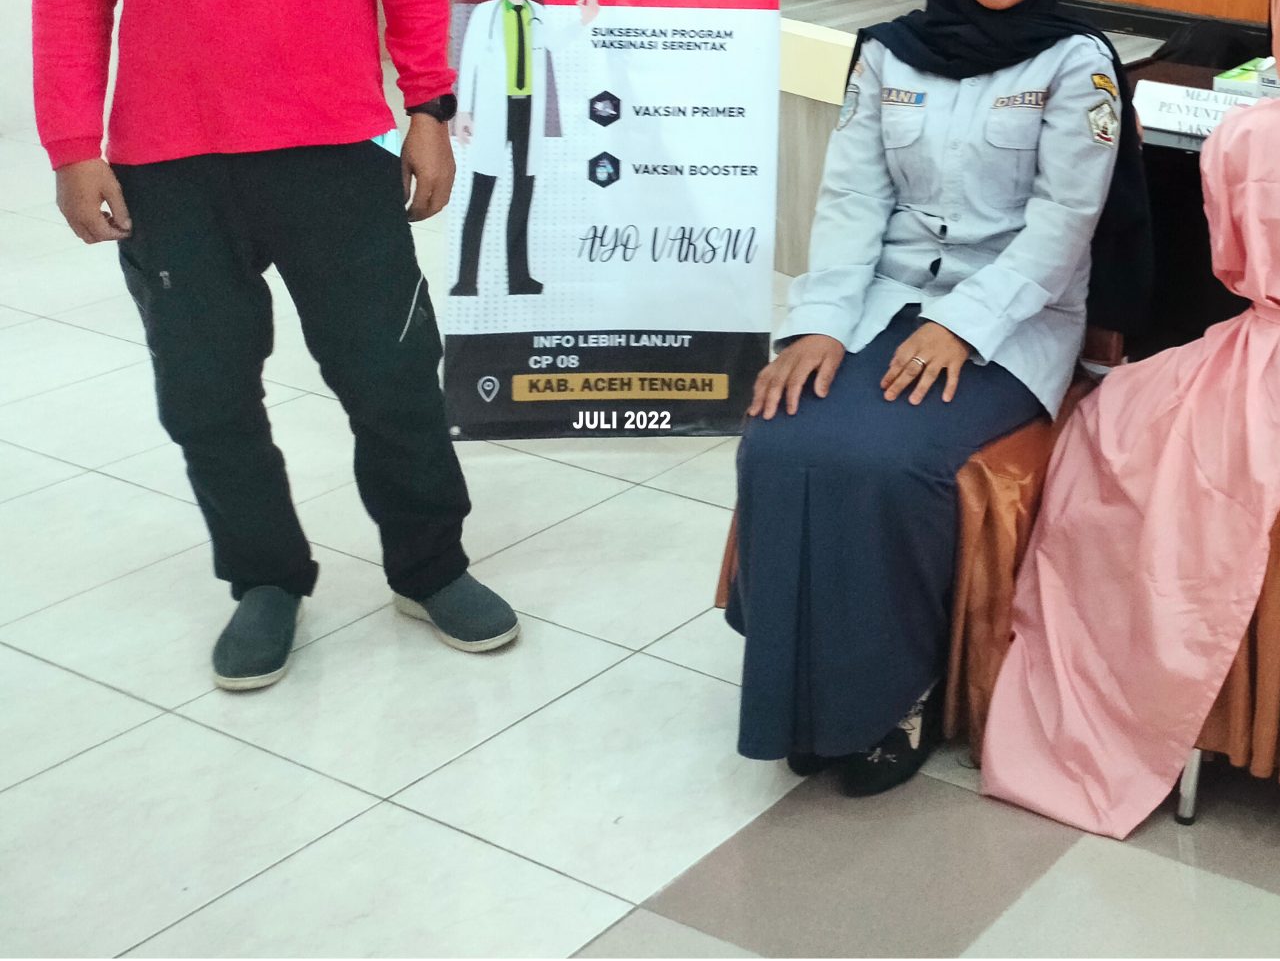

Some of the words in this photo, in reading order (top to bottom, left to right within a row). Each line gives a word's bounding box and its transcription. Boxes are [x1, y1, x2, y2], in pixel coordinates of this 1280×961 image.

[591, 27, 668, 39] SUKSESKAN
[671, 28, 734, 40] PROGRAM
[591, 39, 659, 50] VAKSINASI
[661, 40, 727, 52] SERENTAK
[1184, 89, 1219, 105] MEJA
[632, 105, 688, 118] VAKSIN
[691, 106, 746, 119] PRIMER
[632, 163, 684, 176] VAKSIN
[689, 164, 759, 176] BOOSTER
[578, 224, 642, 263] AYO
[651, 226, 759, 264] VAKSIN
[533, 335, 576, 349] INFO
[578, 335, 627, 348] LEBIH
[629, 334, 693, 348] LANJUT
[528, 355, 554, 369] CP
[556, 355, 580, 368] 08
[528, 379, 575, 393] KAB.
[580, 377, 632, 392] ACEH
[638, 377, 714, 392] TENGAH
[572, 410, 617, 430] JULI
[623, 410, 672, 430] 2022
